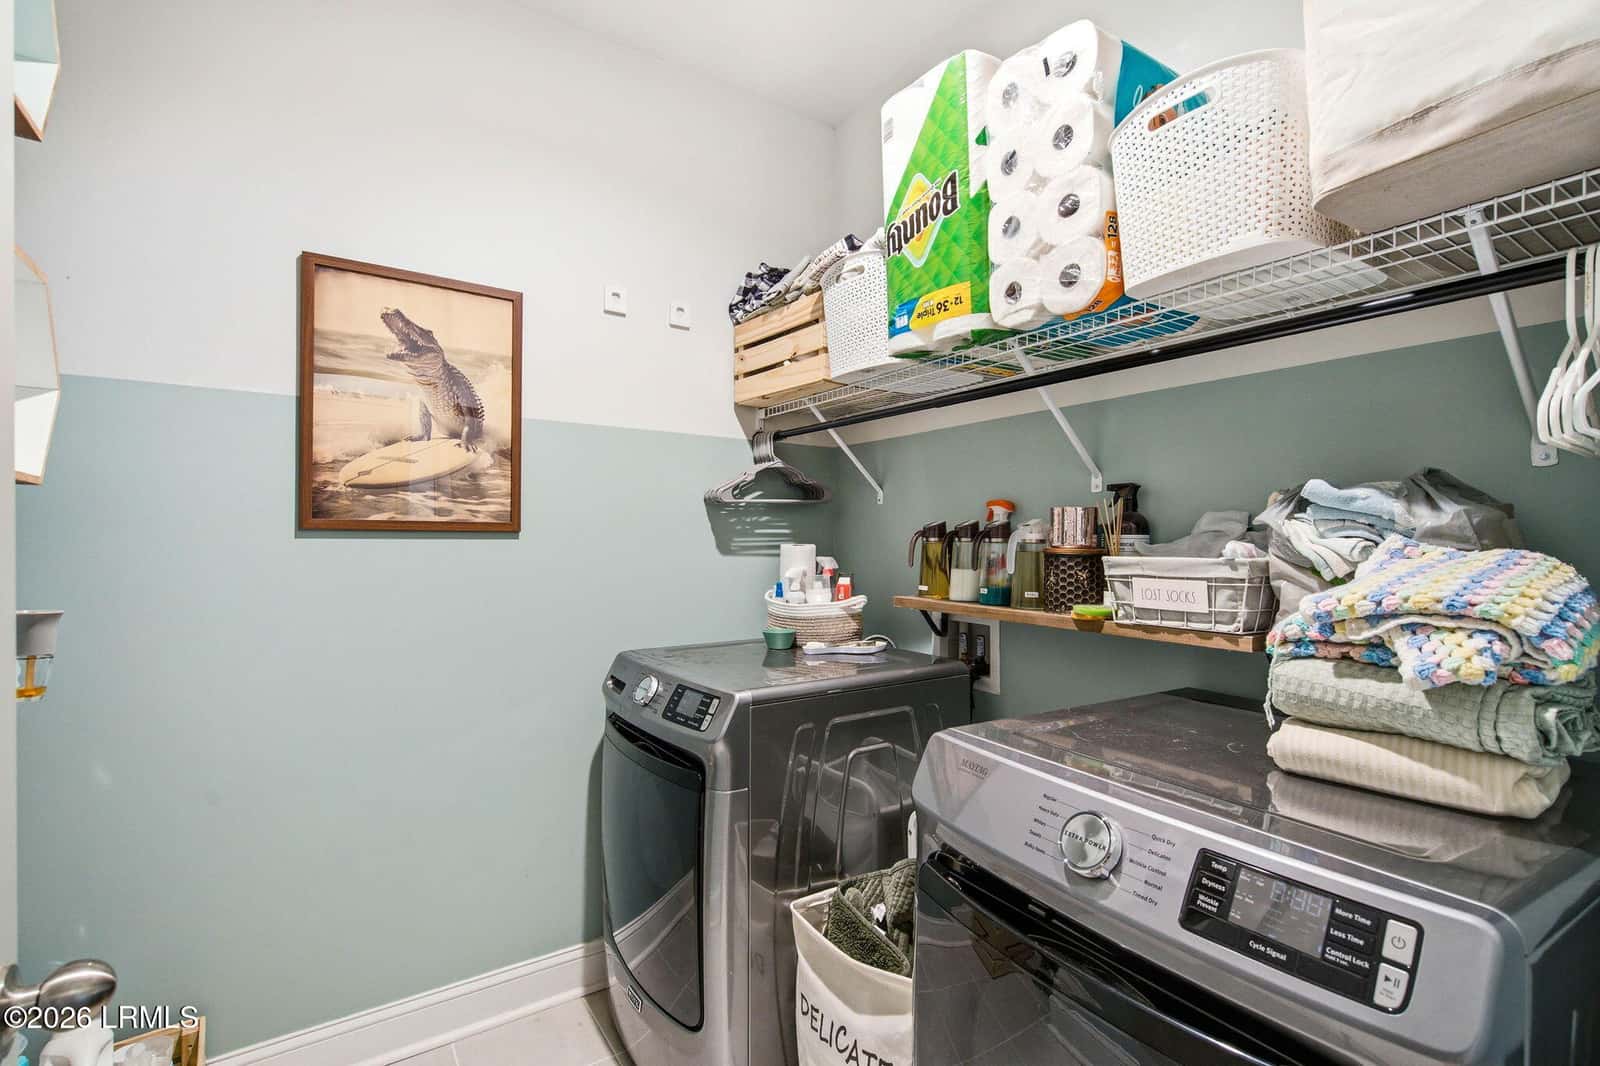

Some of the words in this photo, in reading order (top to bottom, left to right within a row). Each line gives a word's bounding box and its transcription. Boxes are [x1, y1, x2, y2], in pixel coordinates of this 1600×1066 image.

[886, 171, 959, 258] Bounty
[1141, 587, 1161, 601] LOST
[1166, 589, 1196, 604] SOCKS
[1201, 877, 1226, 891] Dryness
[1335, 907, 1354, 920] More
[1354, 914, 1372, 926] Time
[1330, 927, 1347, 939] Less
[1347, 933, 1365, 946] Time
[1249, 940, 1266, 953] Cycle
[1266, 947, 1287, 961] Signal
[1326, 946, 1353, 962] Control
[1352, 956, 1370, 969] Lock
[800, 991, 894, 1066] DELICAT
